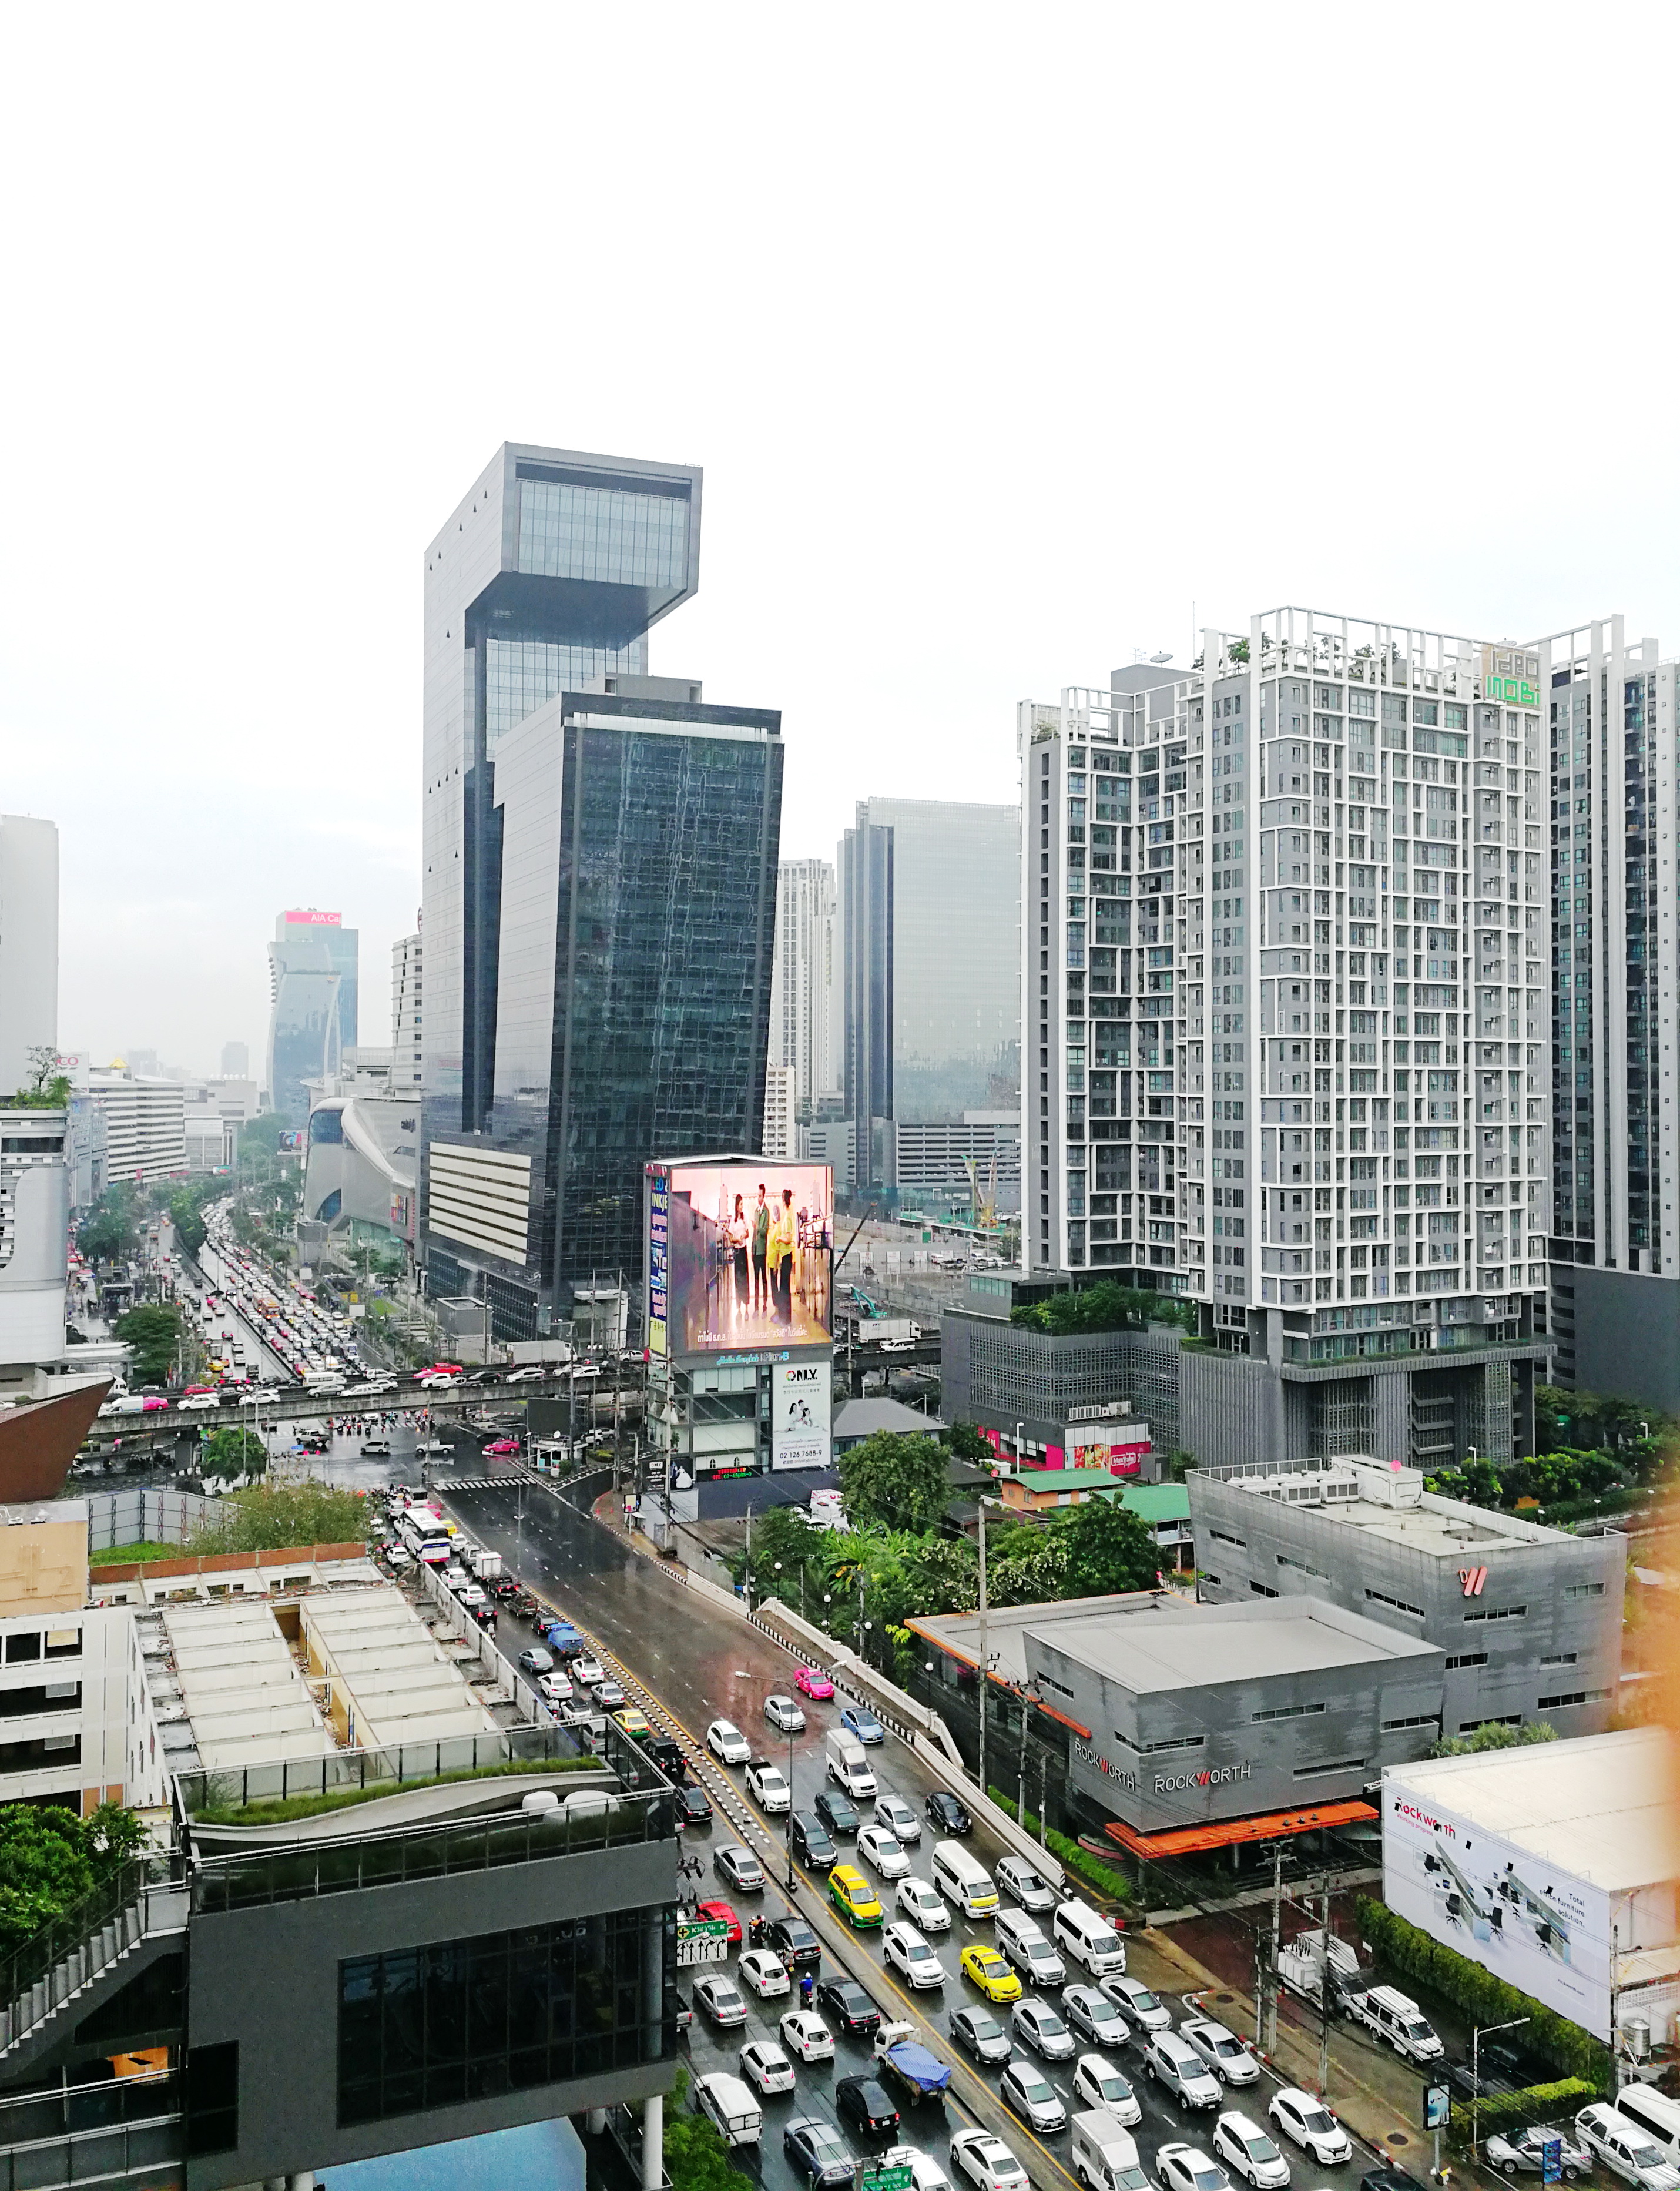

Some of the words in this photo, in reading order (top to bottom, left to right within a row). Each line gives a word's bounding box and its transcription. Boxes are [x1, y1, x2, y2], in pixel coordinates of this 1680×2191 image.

[1075, 1737, 1135, 1791] ROCKWORTH
[1155, 1764, 1251, 1793] ROCKWORTH
[1558, 1897, 1585, 1917] furniture
[1568, 1892, 1585, 1907] Total
